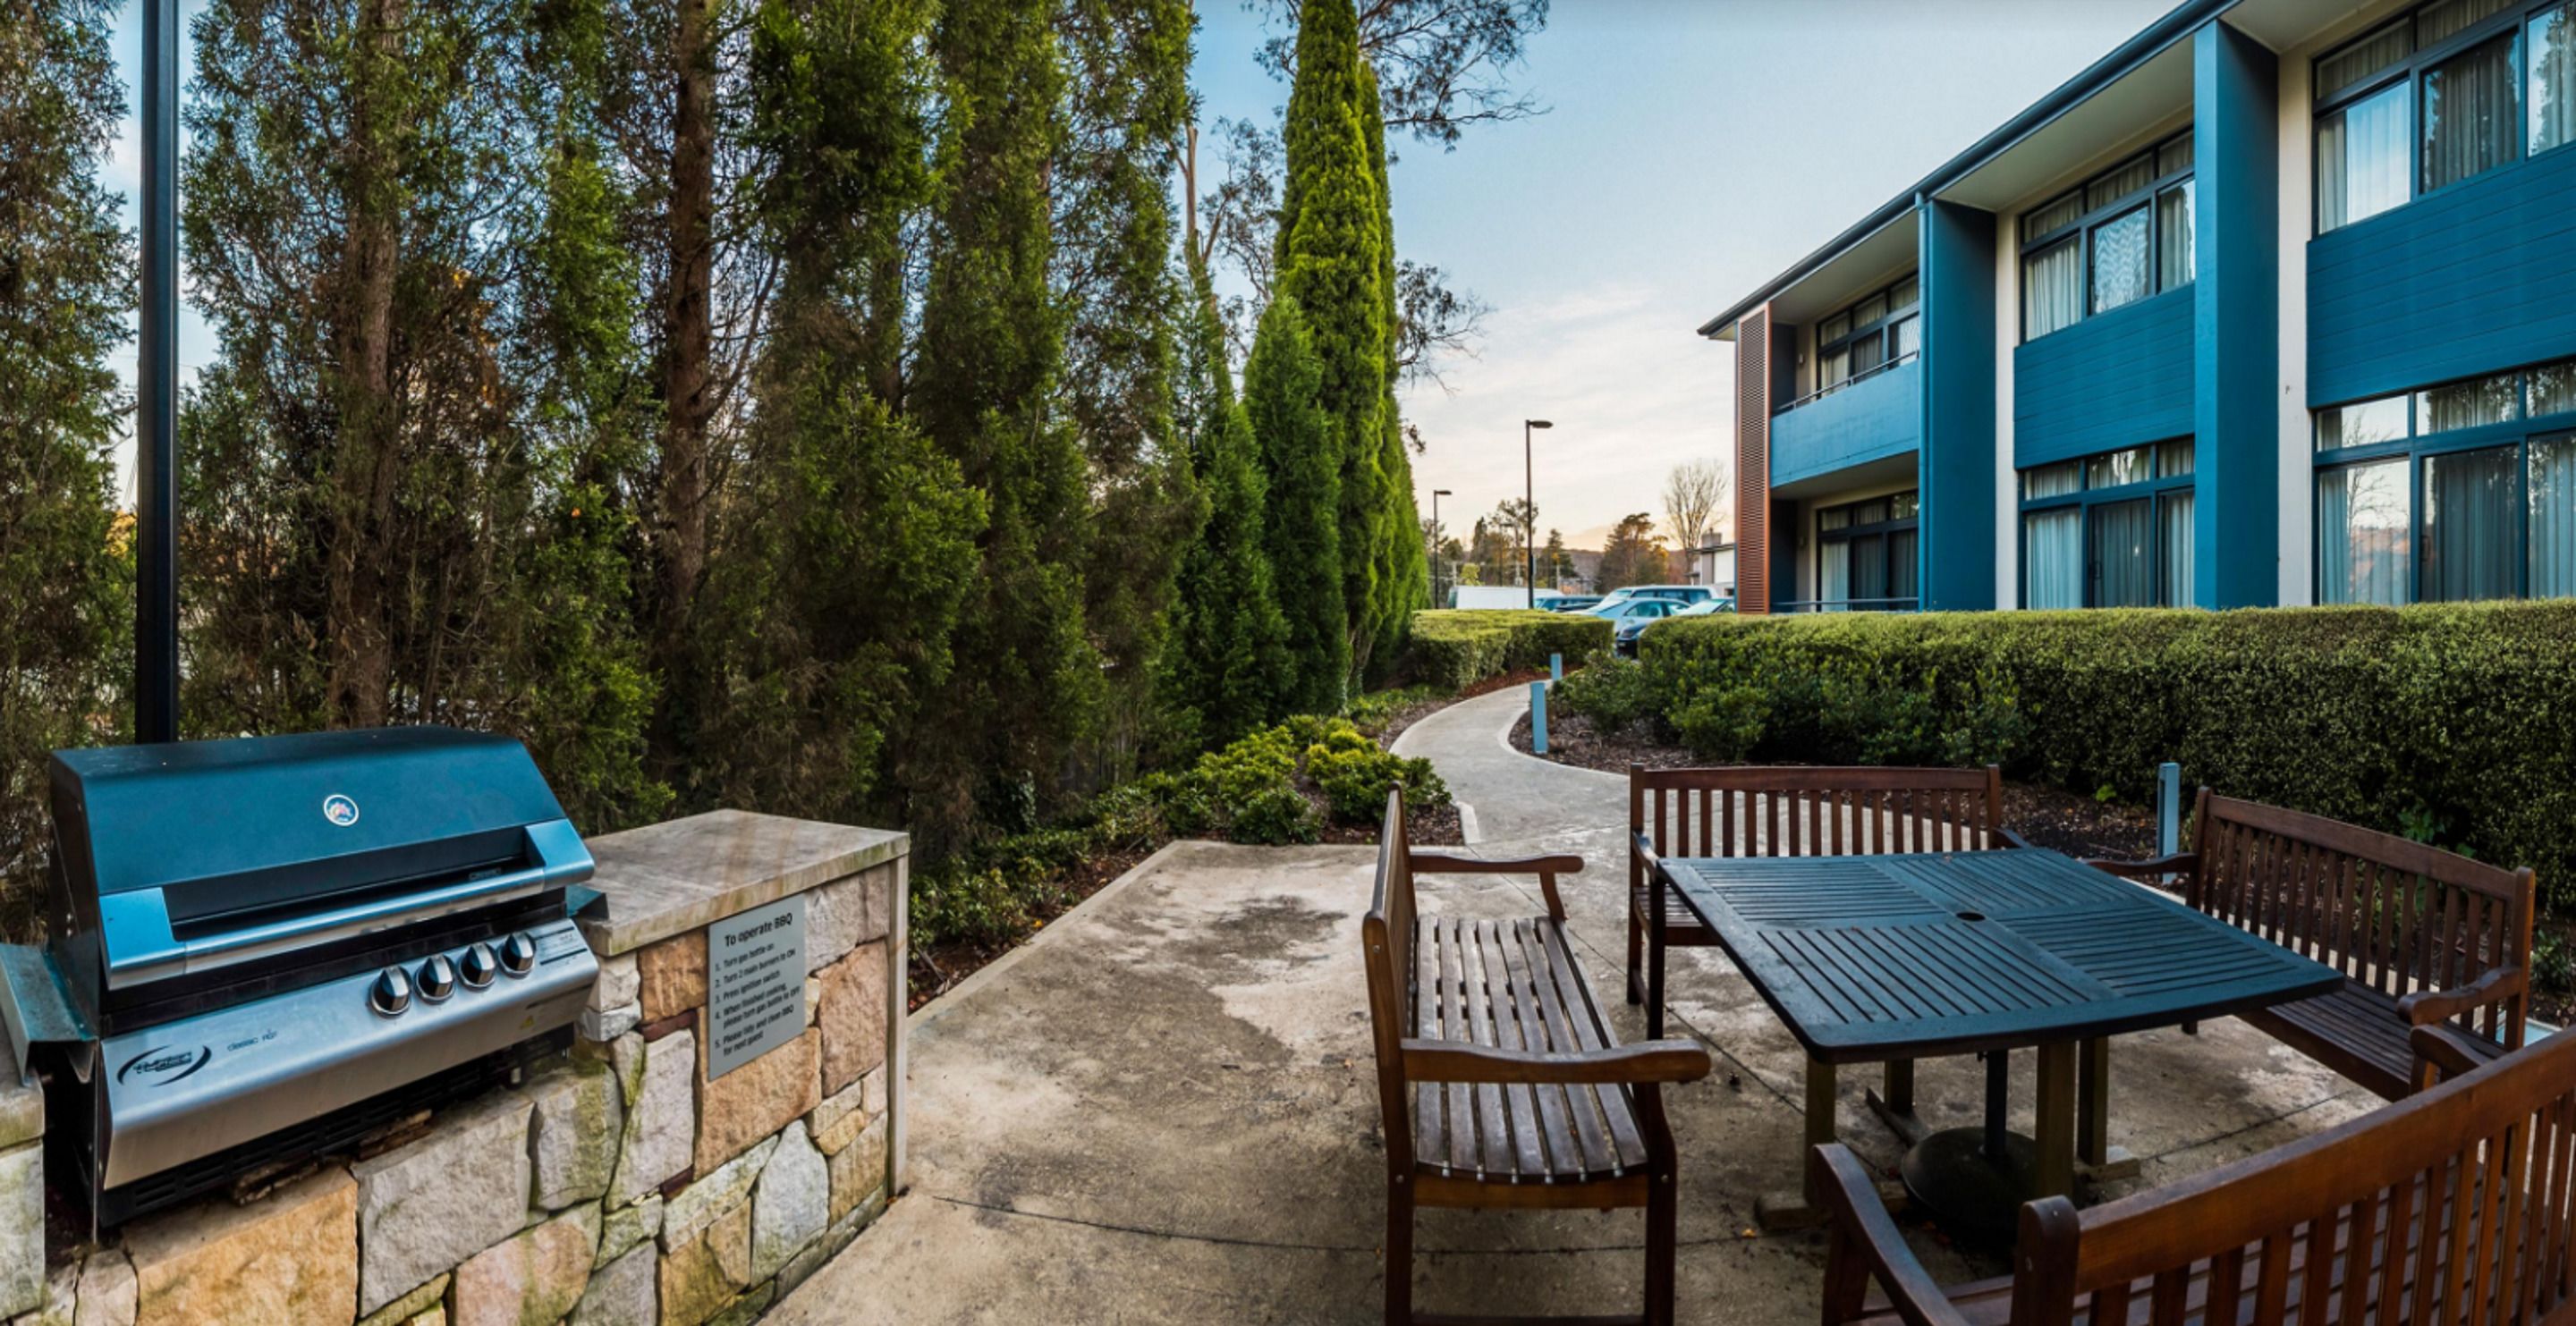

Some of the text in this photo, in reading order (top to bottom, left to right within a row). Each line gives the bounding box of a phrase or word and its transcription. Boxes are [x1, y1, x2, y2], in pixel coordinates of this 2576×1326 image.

[724, 912, 792, 947] To operate BBQ
